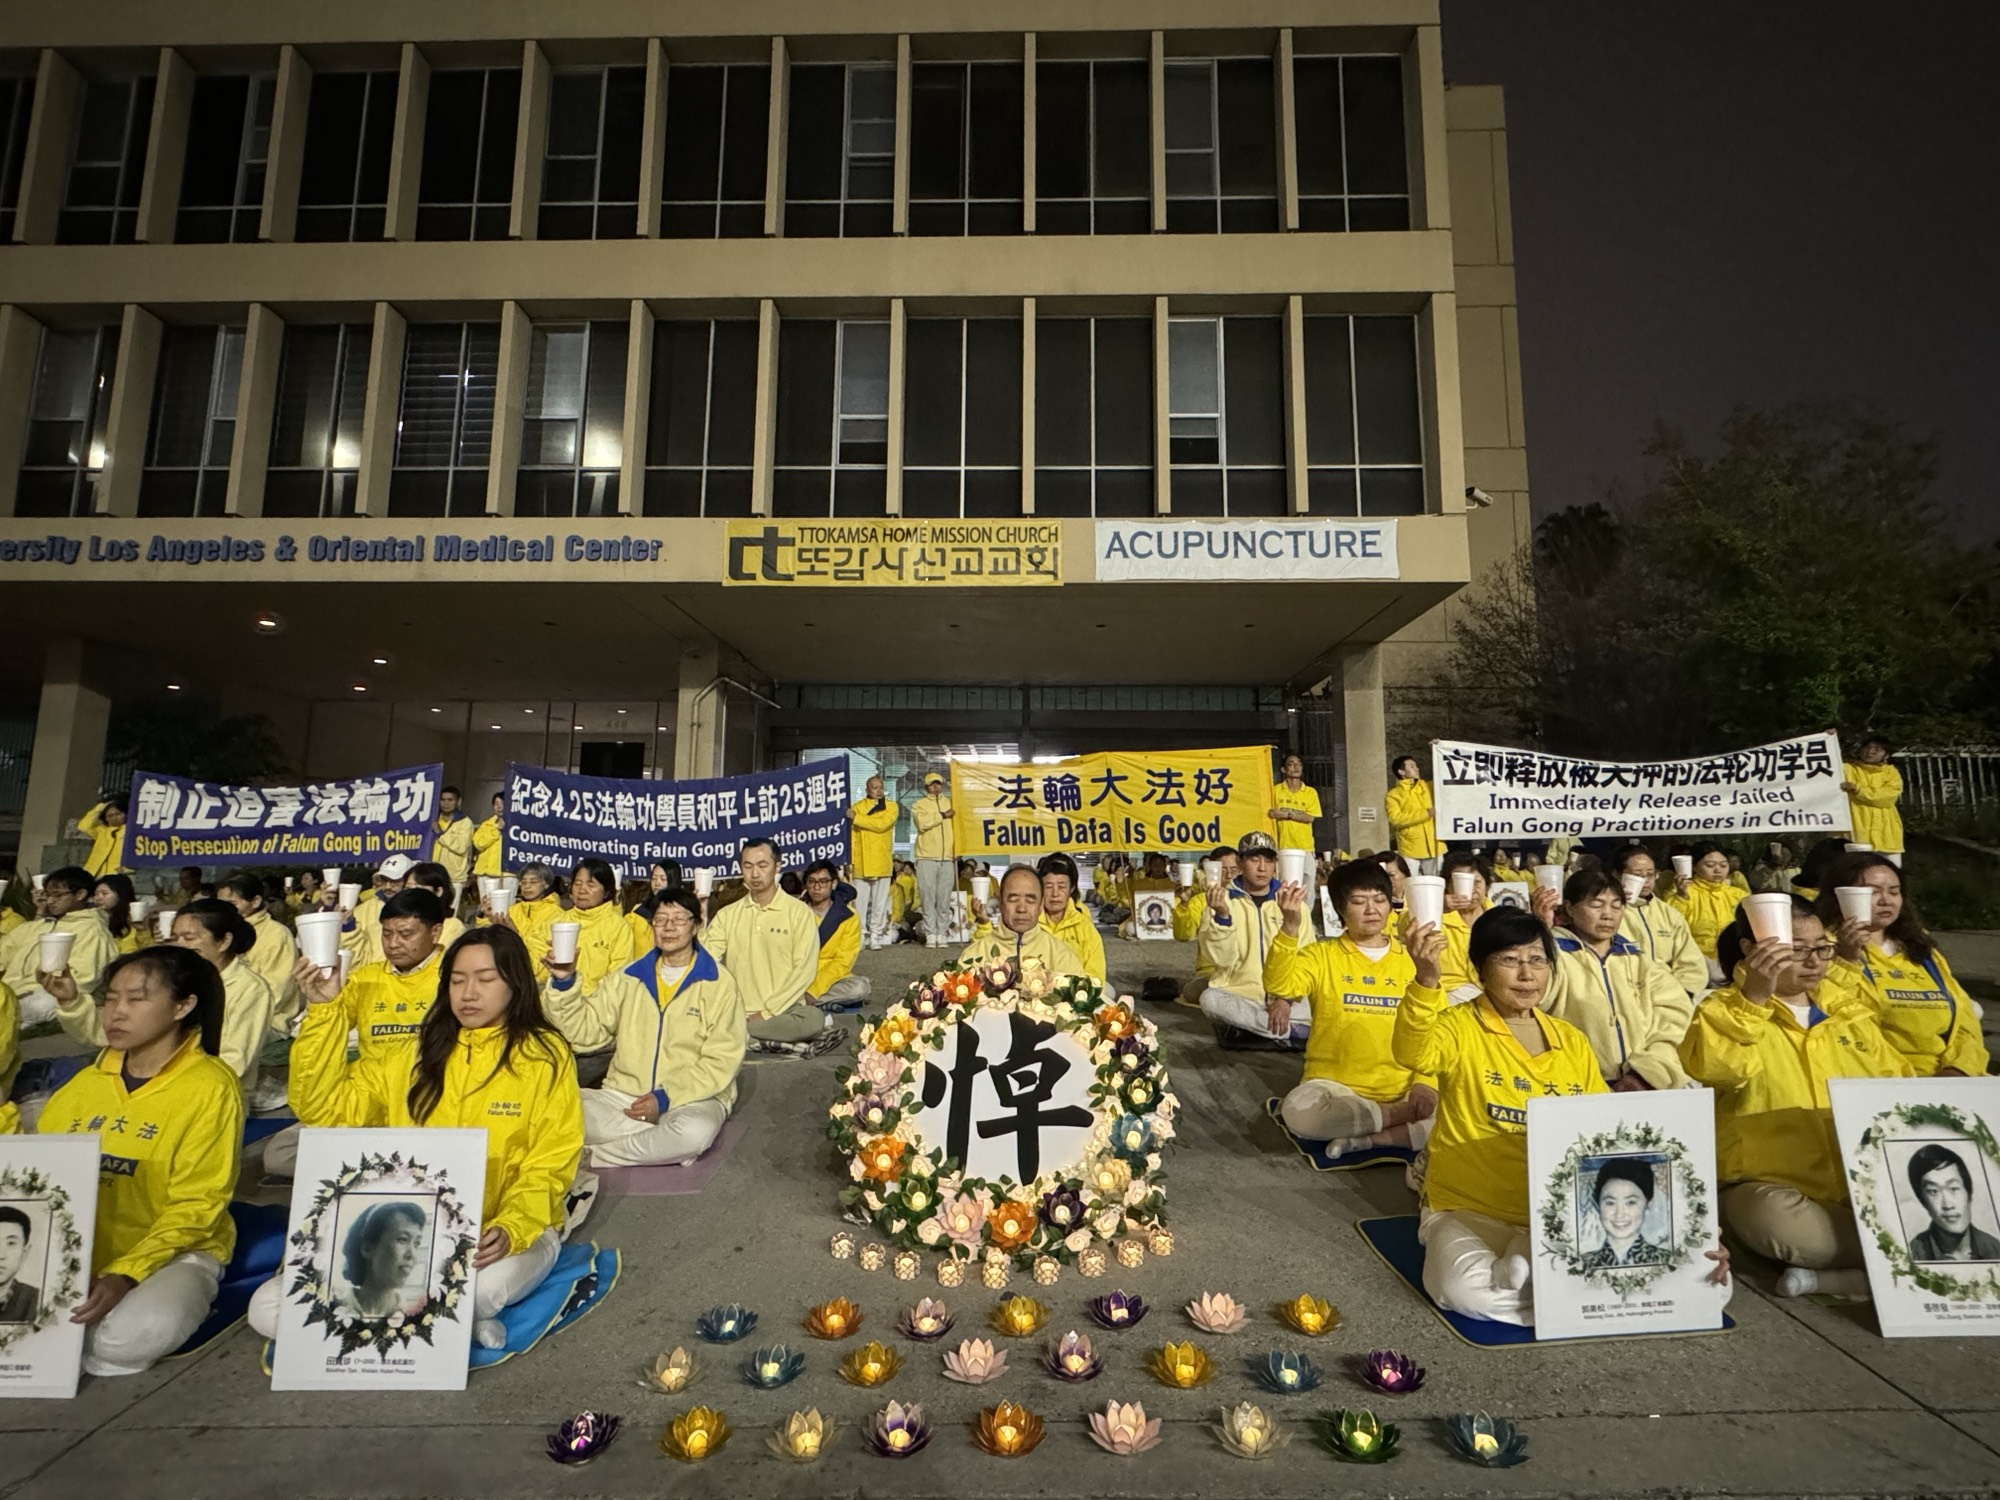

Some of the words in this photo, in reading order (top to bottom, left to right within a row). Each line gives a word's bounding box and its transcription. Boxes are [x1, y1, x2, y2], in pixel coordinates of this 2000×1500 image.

[797, 526, 879, 544] TTOKAMSA
[883, 526, 928, 544] HOME
[931, 526, 994, 544] MISSION
[997, 526, 1059, 544] CHURCH
[1104, 530, 1382, 559] ACUPUNCTURE
[89, 536, 139, 561] Los
[146, 536, 264, 564] Angeles
[275, 536, 297, 562] &
[308, 536, 424, 562] Oriental
[433, 536, 555, 562] Medical
[564, 536, 663, 562] Center
[993, 767, 1233, 812] 法輪大法好
[1489, 793, 1632, 814] Immediately
[1639, 792, 1721, 809] Release
[1729, 786, 1796, 805] Jailed
[983, 819, 1045, 846] Falun
[1057, 817, 1112, 844] Dafa
[1124, 817, 1147, 844] Is
[1159, 814, 1221, 844] Good
[1453, 817, 1513, 834] Falun
[1521, 817, 1584, 836] Gong
[1591, 814, 1735, 833] Practitioners
[1741, 812, 1761, 828] in
[1768, 809, 1834, 827] China
[134, 835, 168, 860] Stop
[171, 835, 259, 856] Persecution
[262, 833, 279, 854] of
[280, 832, 319, 854] Falun
[323, 833, 362, 855] Gong
[365, 831, 379, 850] in
[384, 829, 422, 851] China
[509, 825, 640, 860] Commemorating
[644, 841, 687, 858] Falun
[691, 842, 735, 859] Gong
[508, 847, 573, 869] Peaceful
[632, 862, 647, 877] in
[780, 850, 805, 868] 5th
[809, 842, 845, 862] 1999
[1346, 995, 1383, 1006] FALUN
[373, 1025, 410, 1035] FALUN
[921, 1012, 1095, 1187] 悼
[100, 1158, 131, 1174] AFA
